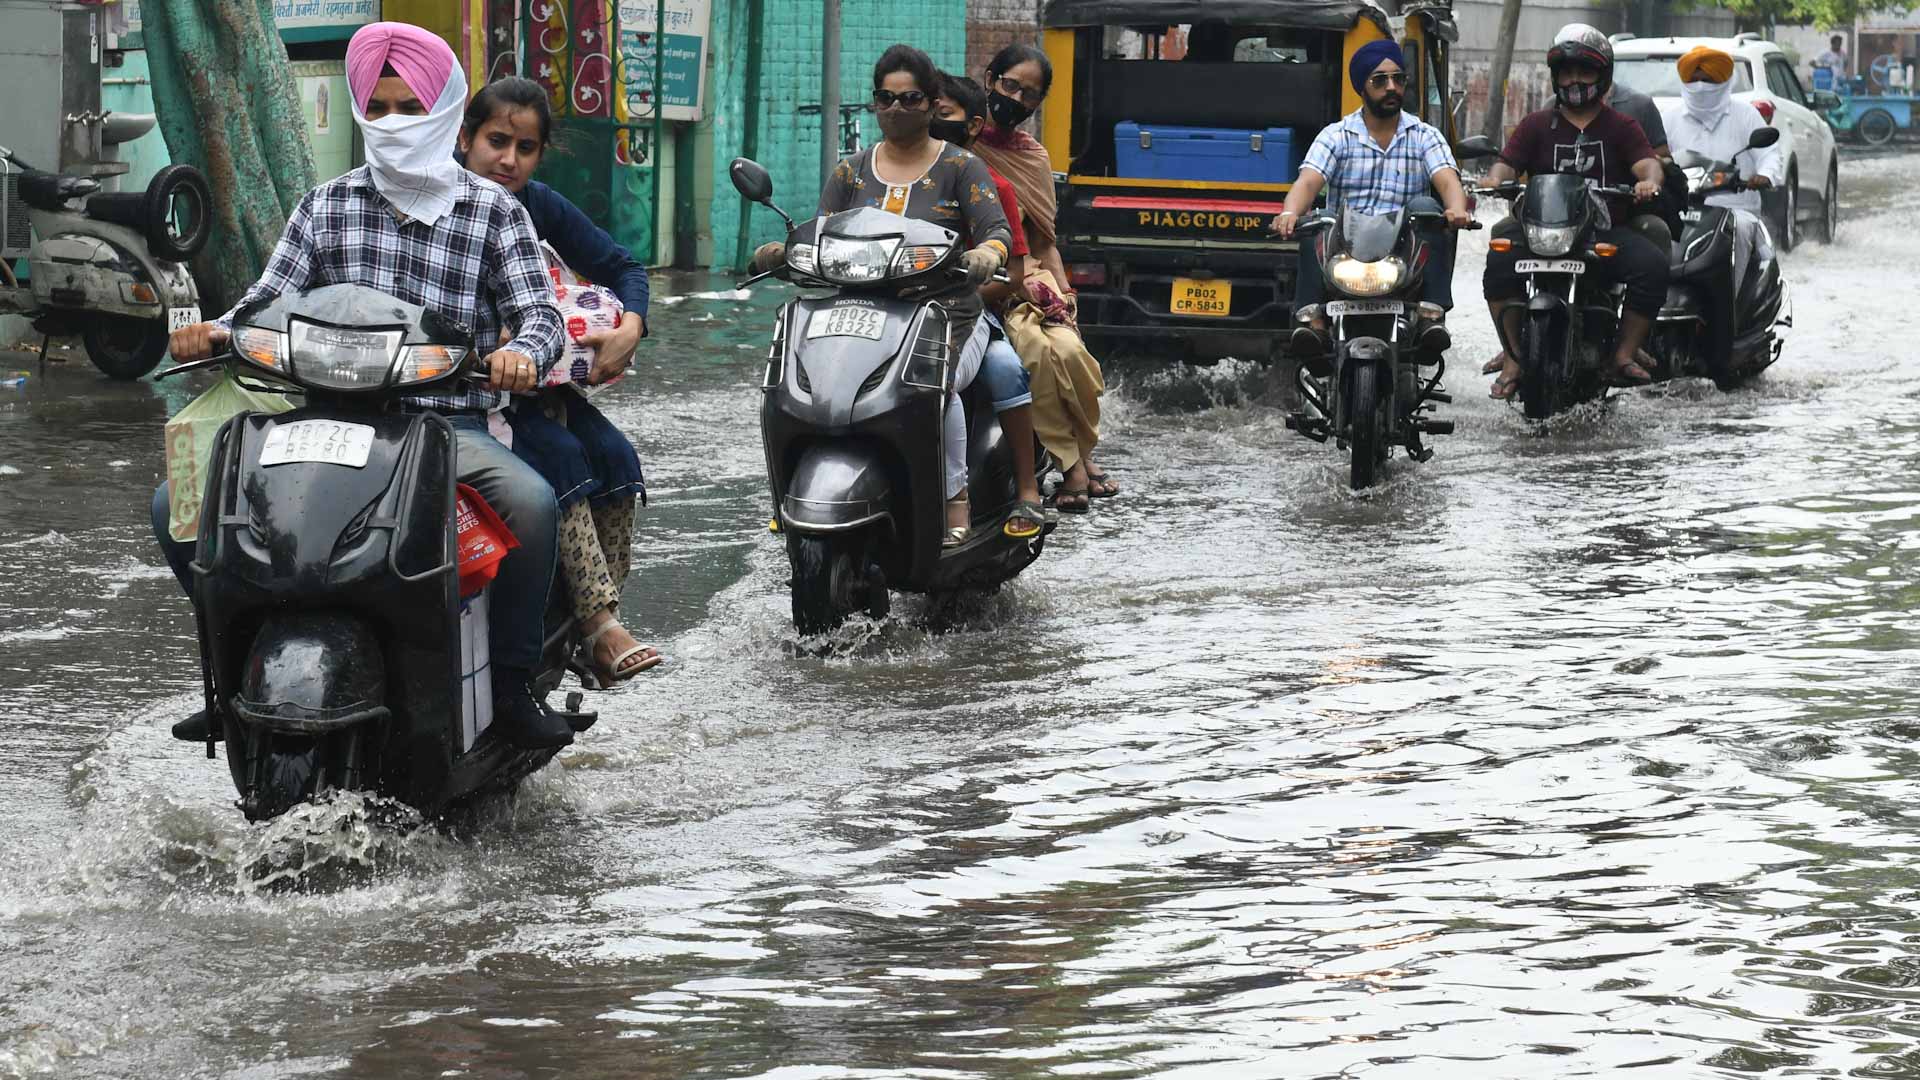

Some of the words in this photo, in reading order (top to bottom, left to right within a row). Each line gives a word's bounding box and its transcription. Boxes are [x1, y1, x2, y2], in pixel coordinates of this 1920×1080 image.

[1234, 216, 1261, 231] ape
[1187, 288, 1217, 299] PB02
[830, 308, 879, 323] PB02C
[825, 320, 876, 337] K8322
[457, 517, 480, 534] EETS
